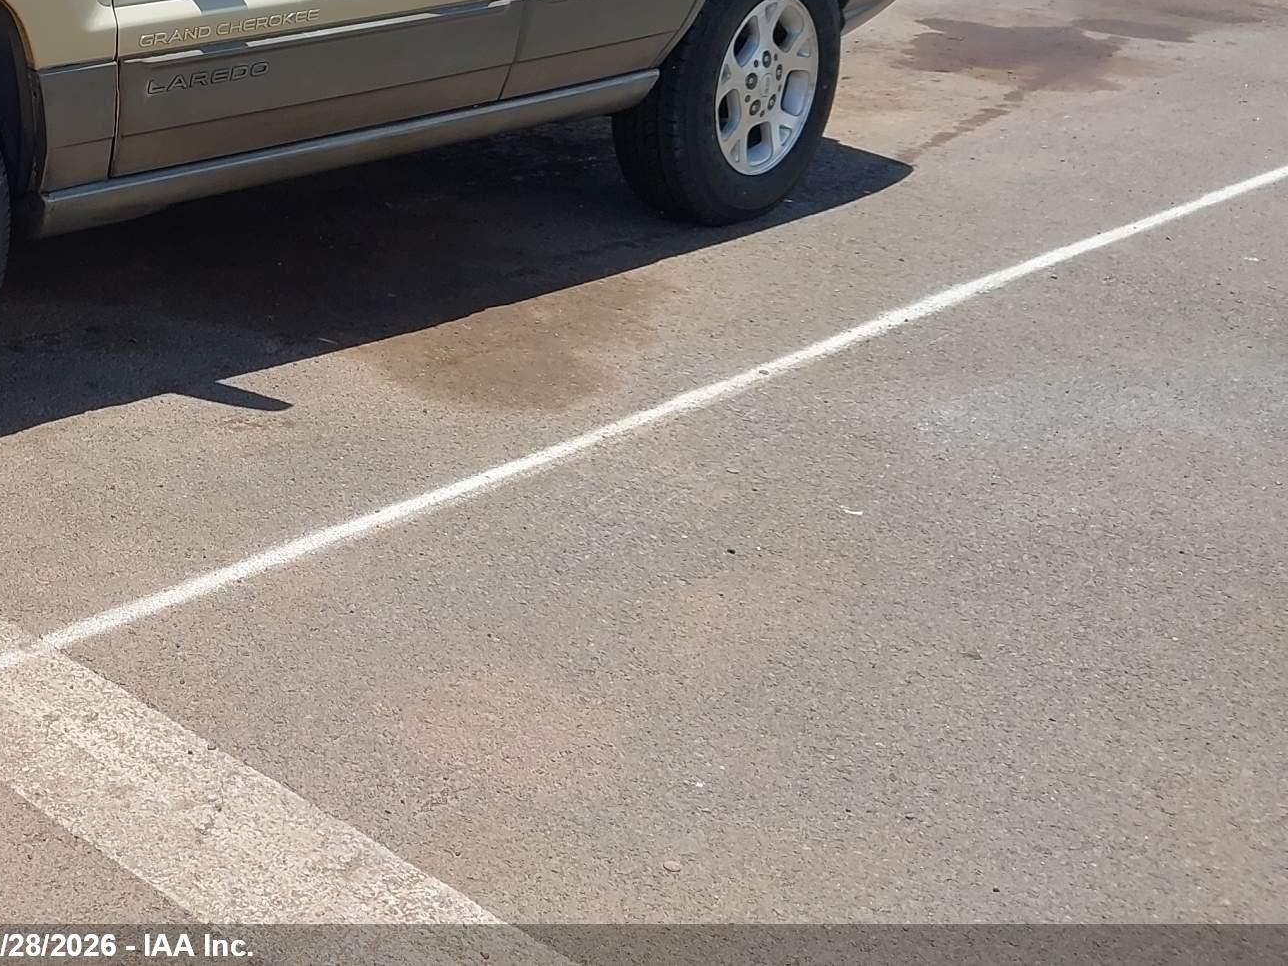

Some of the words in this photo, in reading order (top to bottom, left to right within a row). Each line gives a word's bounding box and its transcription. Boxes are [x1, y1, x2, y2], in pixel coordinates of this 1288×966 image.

[139, 24, 212, 47] GRAND
[215, 8, 321, 35] CHEROKEE
[146, 62, 269, 96] LAREDO
